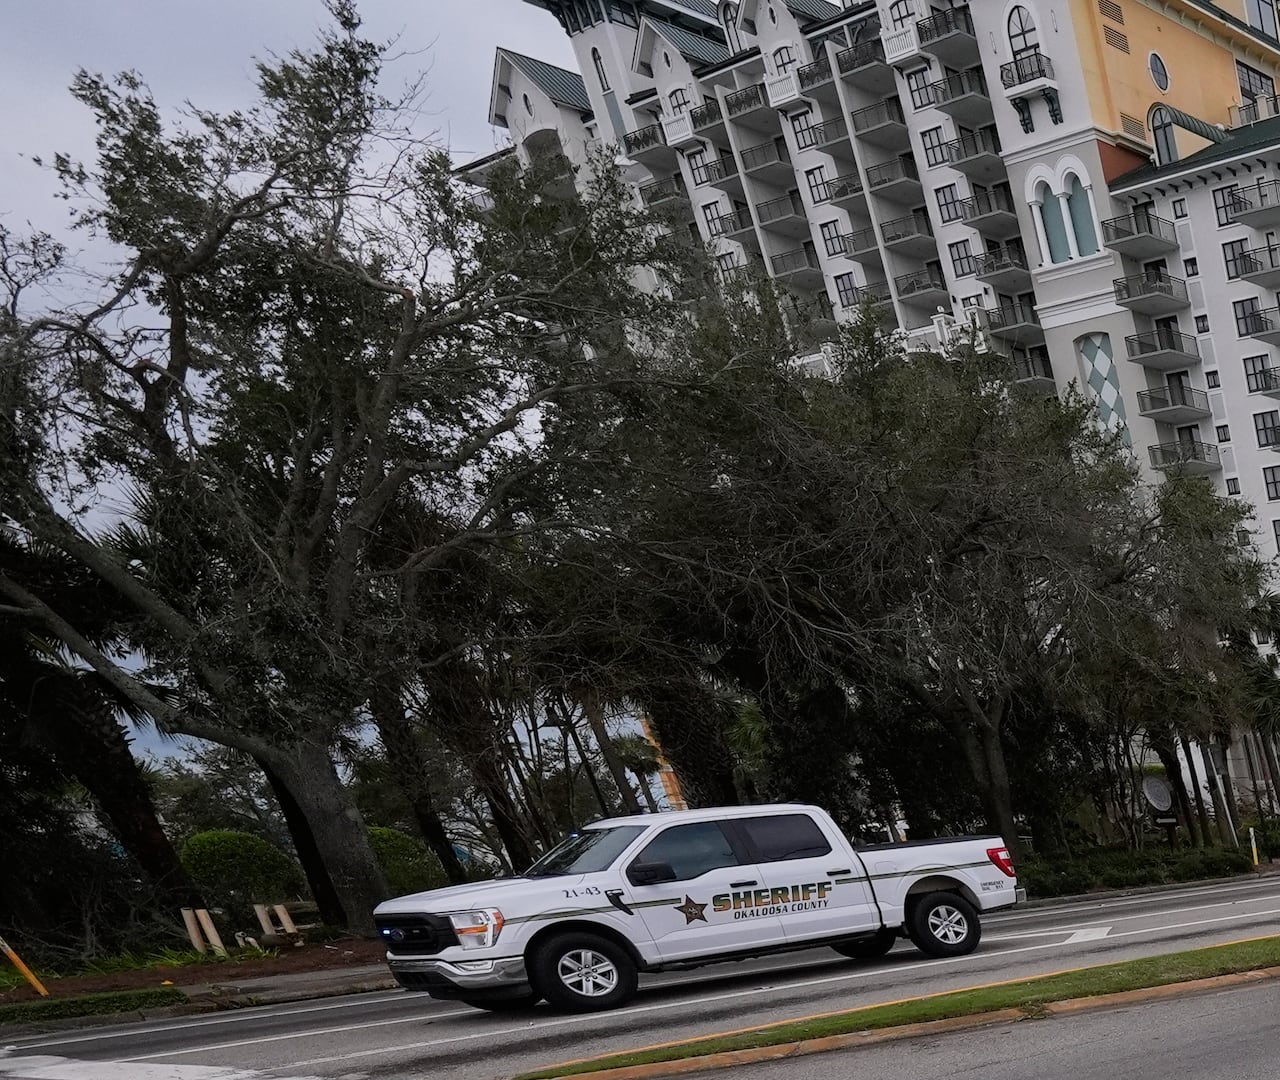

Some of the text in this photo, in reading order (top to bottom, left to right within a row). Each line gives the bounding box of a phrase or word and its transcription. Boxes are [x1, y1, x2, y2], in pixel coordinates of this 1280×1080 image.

[562, 886, 602, 899] 21-43
[712, 881, 833, 912] SHERIFF
[734, 900, 830, 920] OKALOOSA COUNTY
